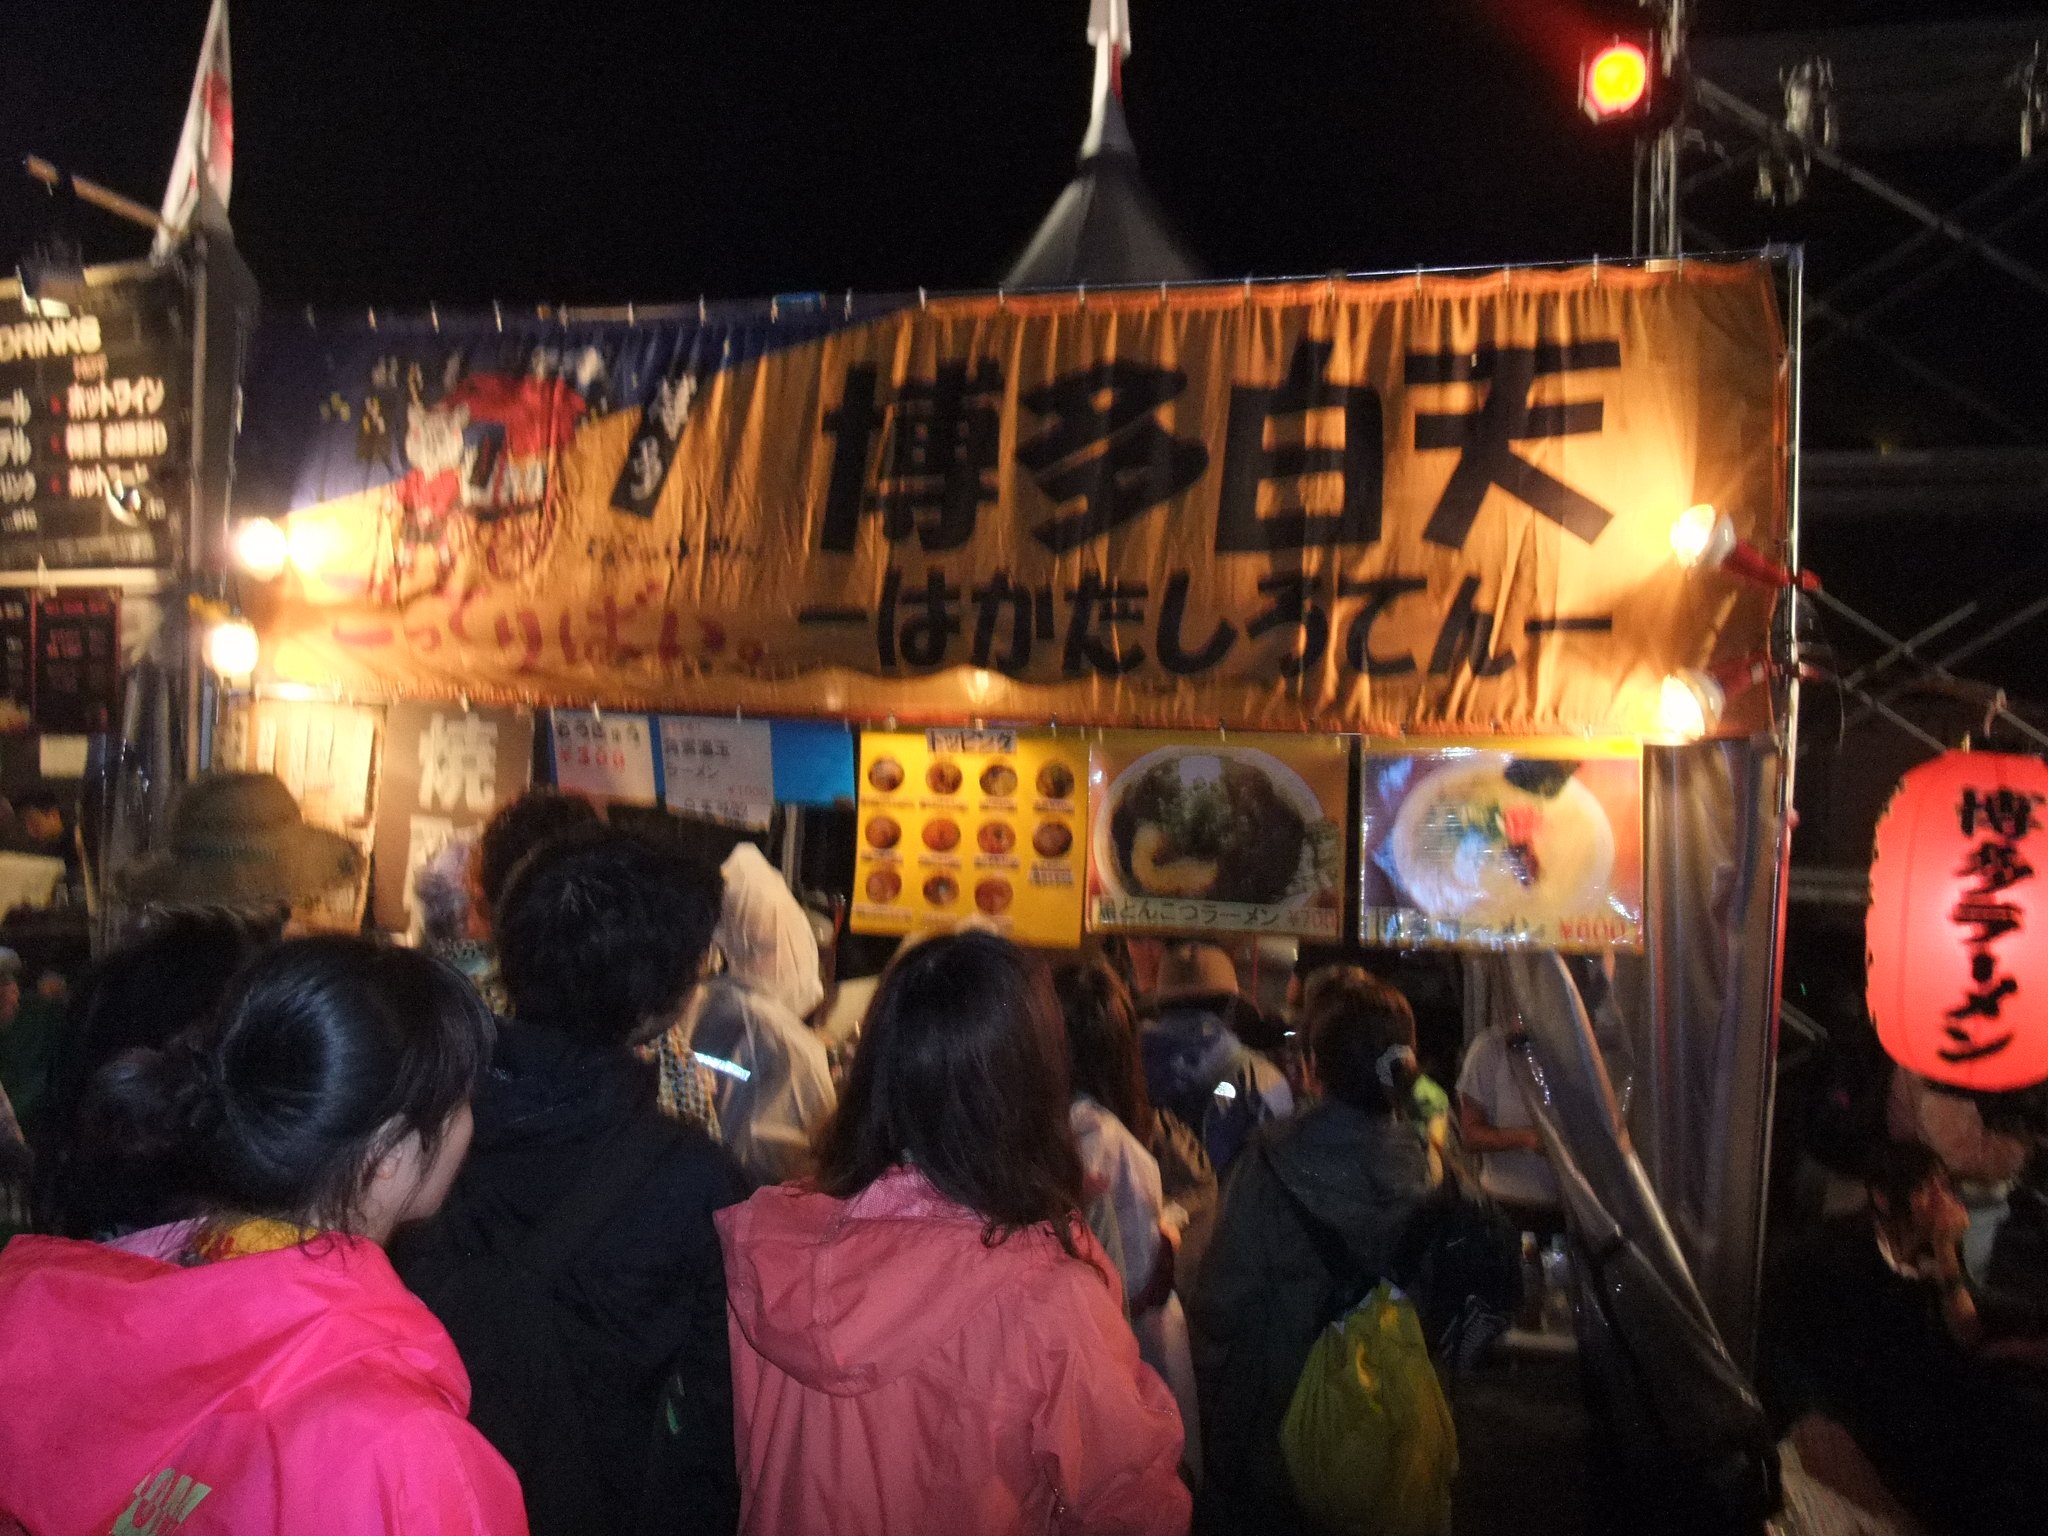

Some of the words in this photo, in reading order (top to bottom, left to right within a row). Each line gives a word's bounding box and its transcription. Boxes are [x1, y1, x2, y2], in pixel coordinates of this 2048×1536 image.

[821, 335, 1621, 556] 博多白天
[1936, 786, 2046, 1064] 博多ラーメン
